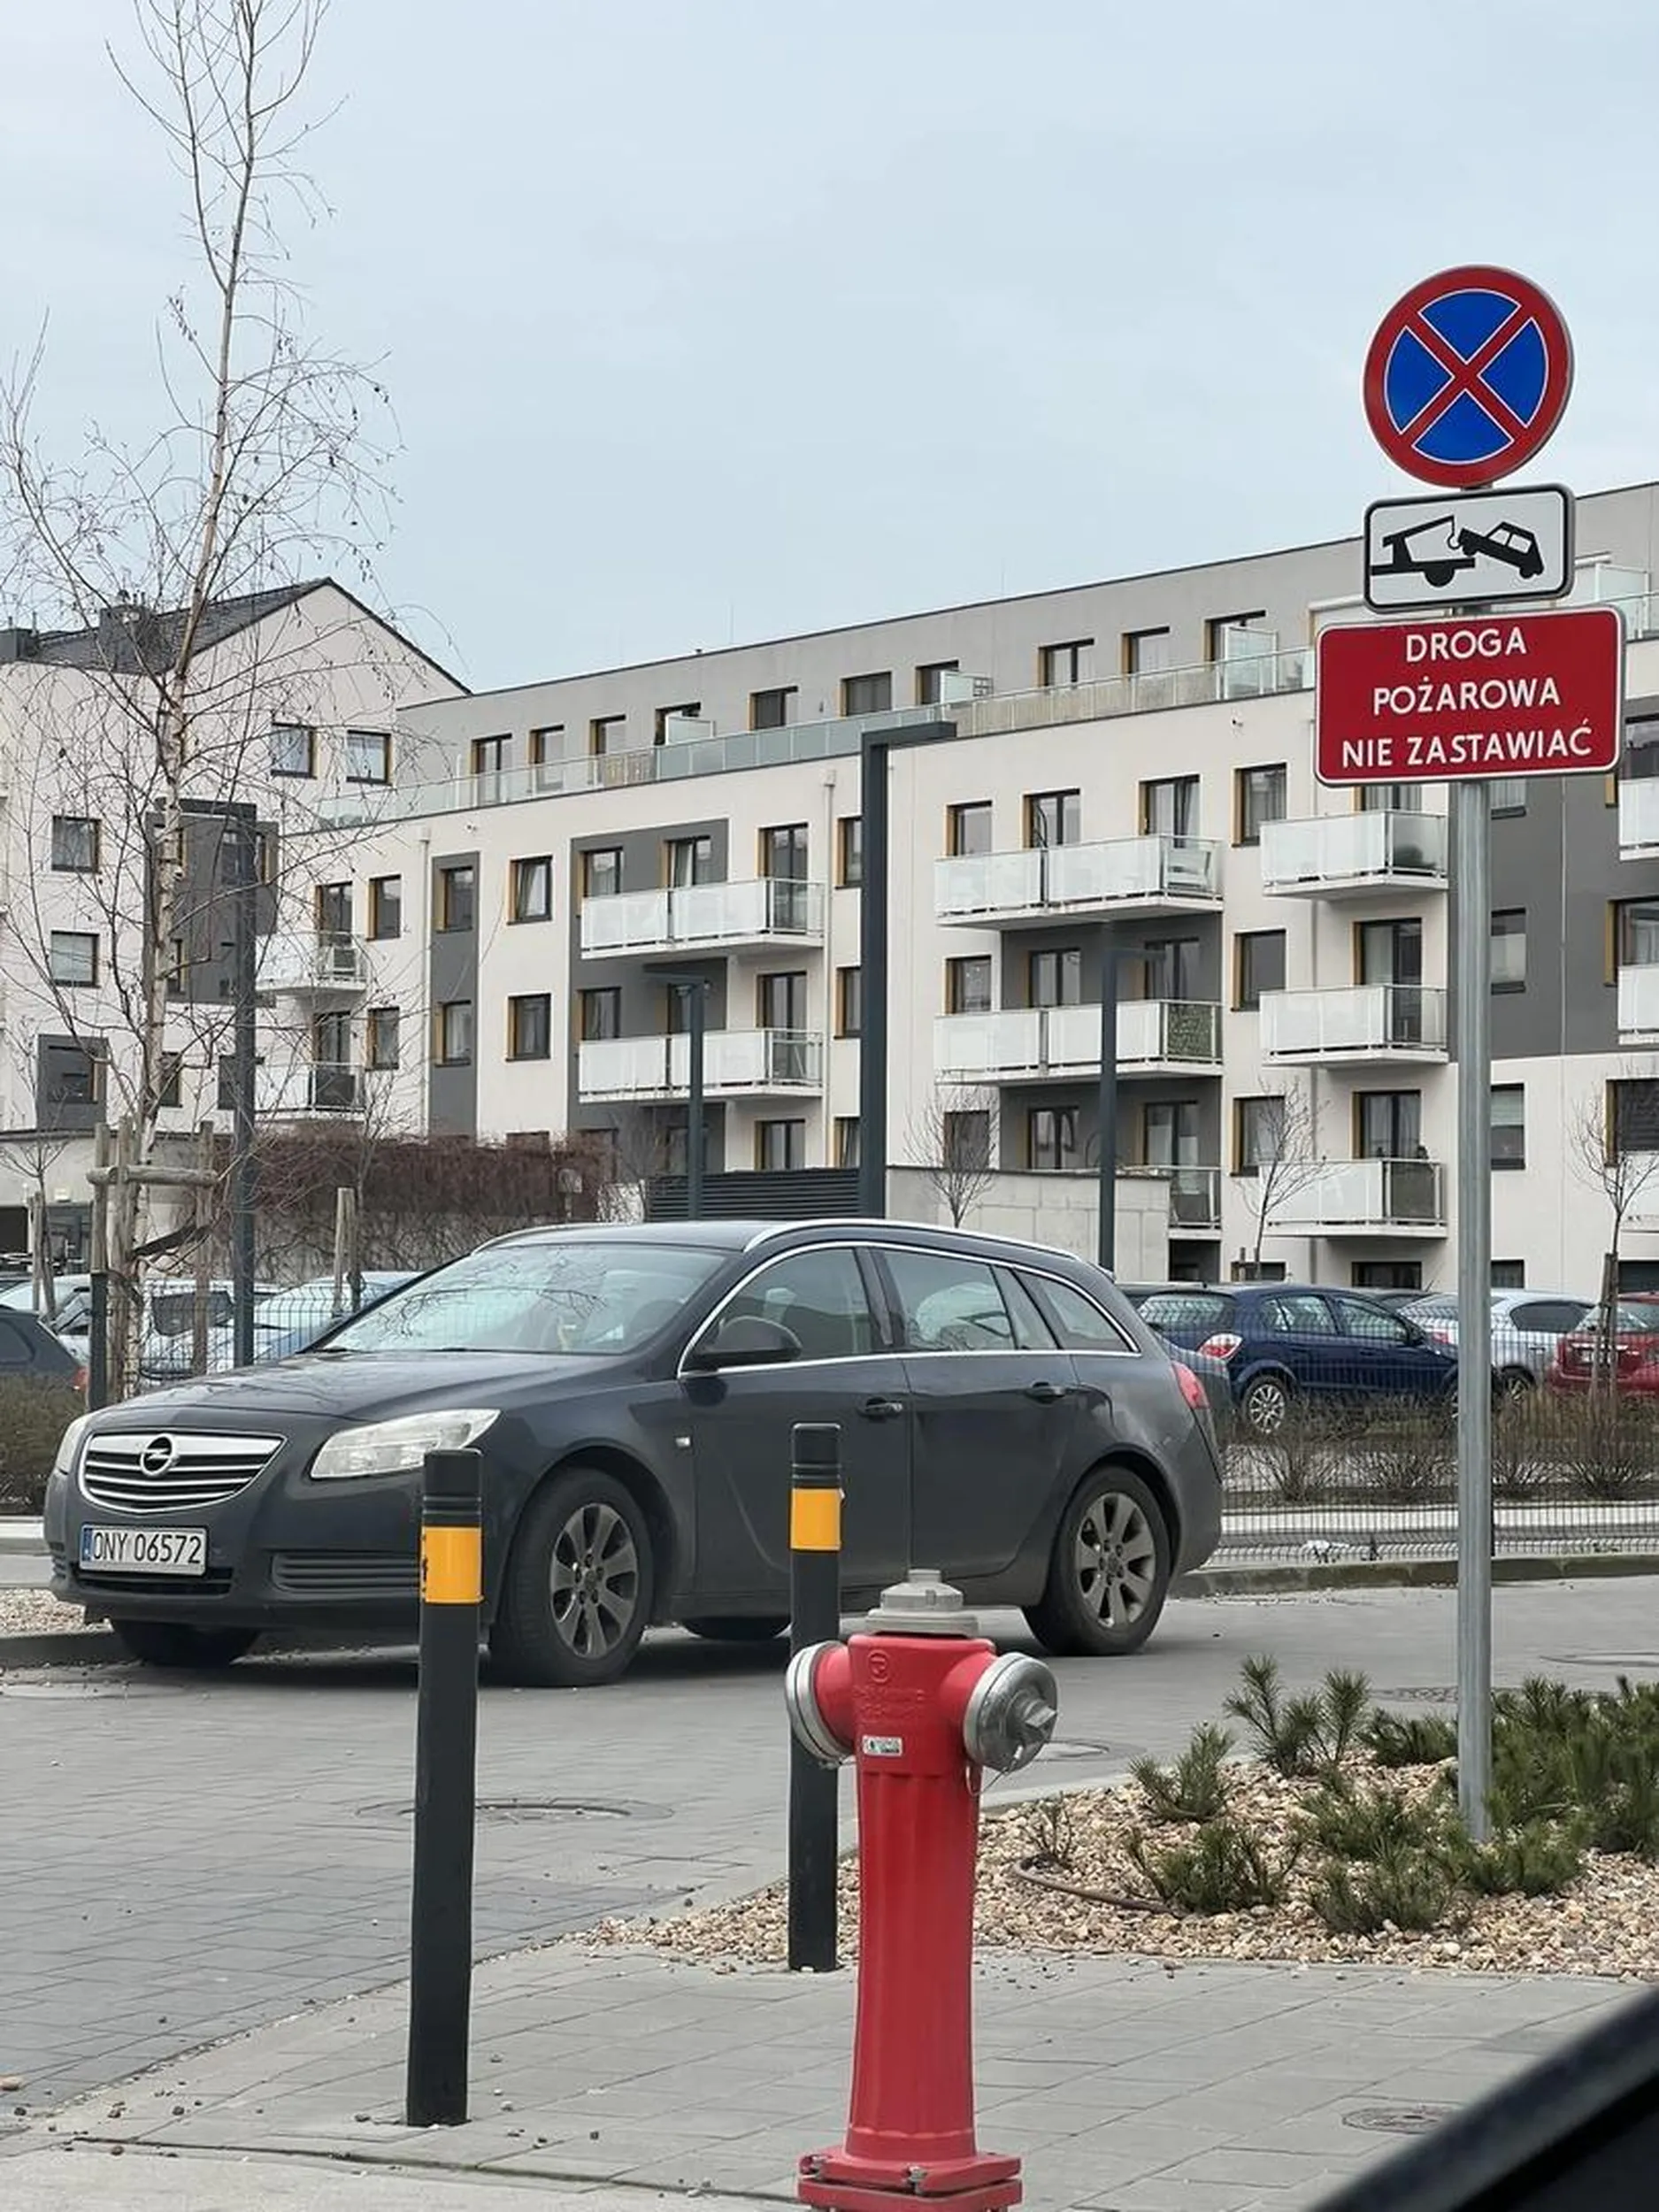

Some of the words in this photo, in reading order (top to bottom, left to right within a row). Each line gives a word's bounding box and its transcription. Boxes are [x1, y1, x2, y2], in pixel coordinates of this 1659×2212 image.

[1406, 627, 1527, 663] DROGA
[1373, 677, 1560, 716] POŻAROWA
[1342, 738, 1393, 768] NIE
[1406, 718, 1593, 765] ZASTAWIAĆ
[93, 1532, 128, 1560] ONY
[134, 1533, 202, 1564] 06572
